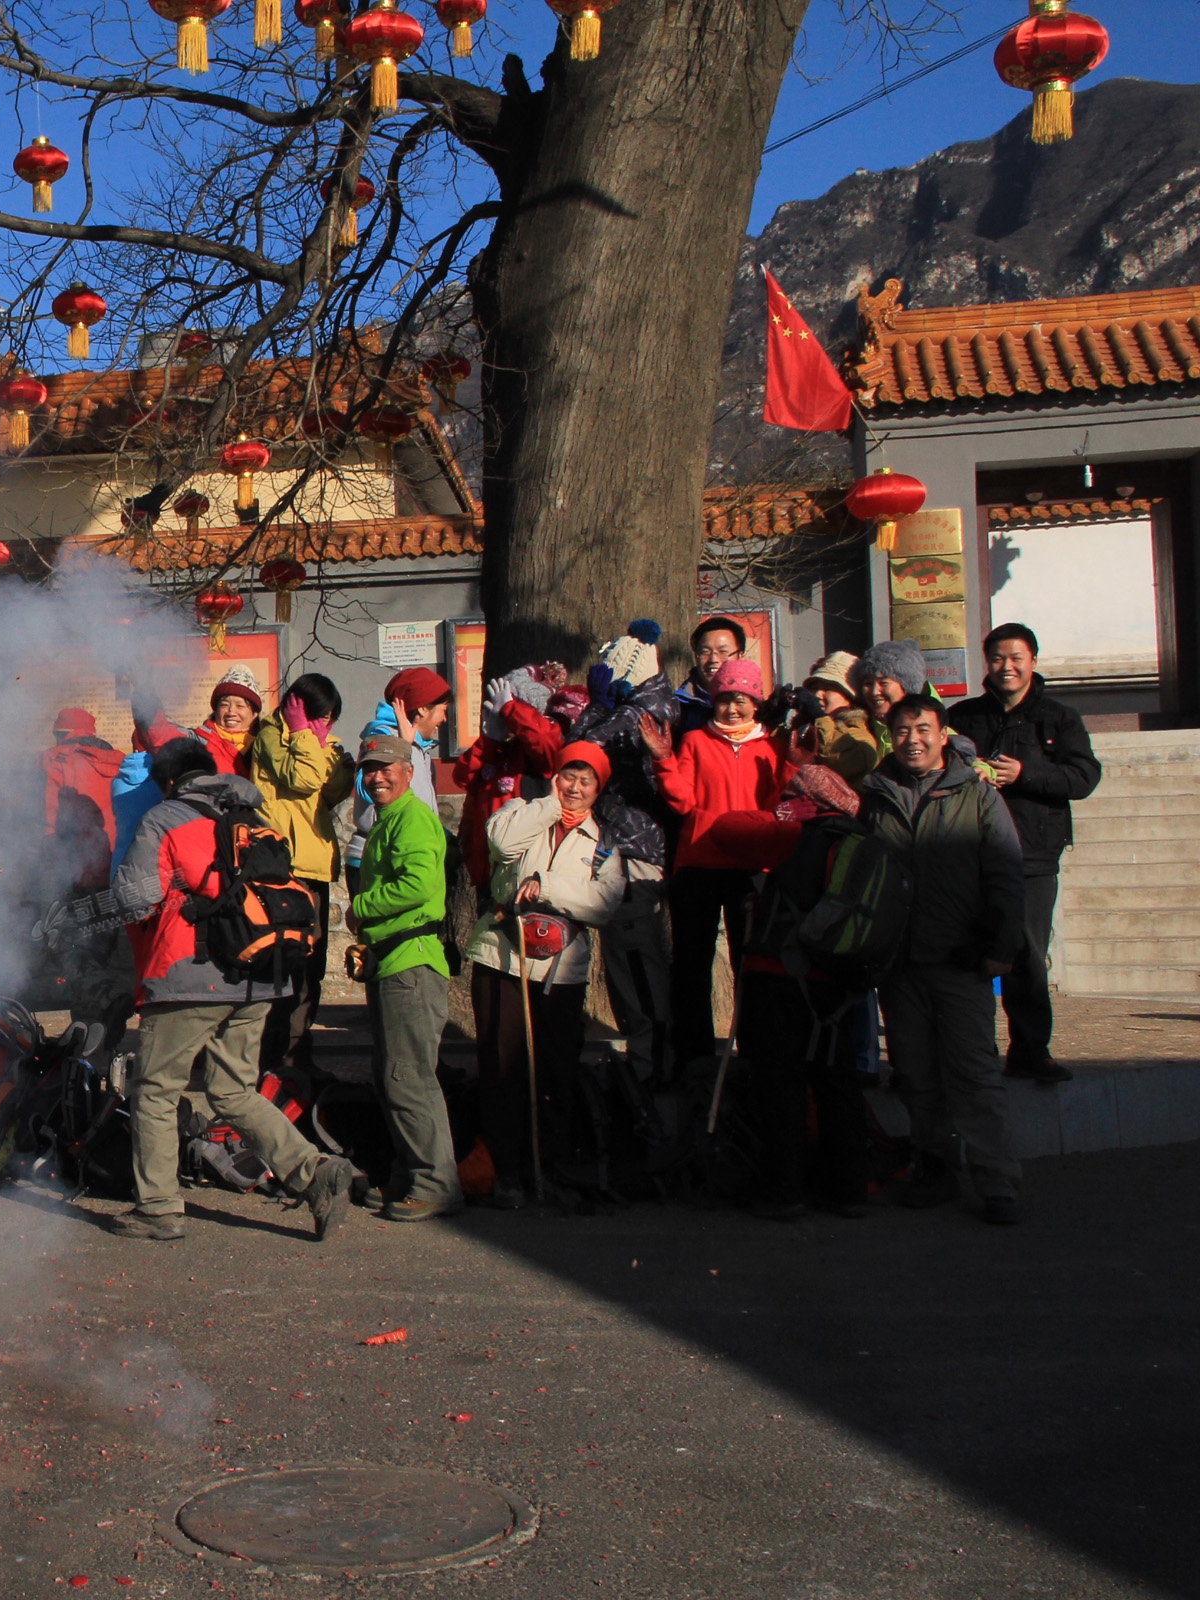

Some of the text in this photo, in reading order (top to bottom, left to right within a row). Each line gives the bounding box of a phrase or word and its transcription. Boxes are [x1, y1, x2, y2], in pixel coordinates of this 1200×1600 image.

[905, 590, 951, 599] 党员服务中心
